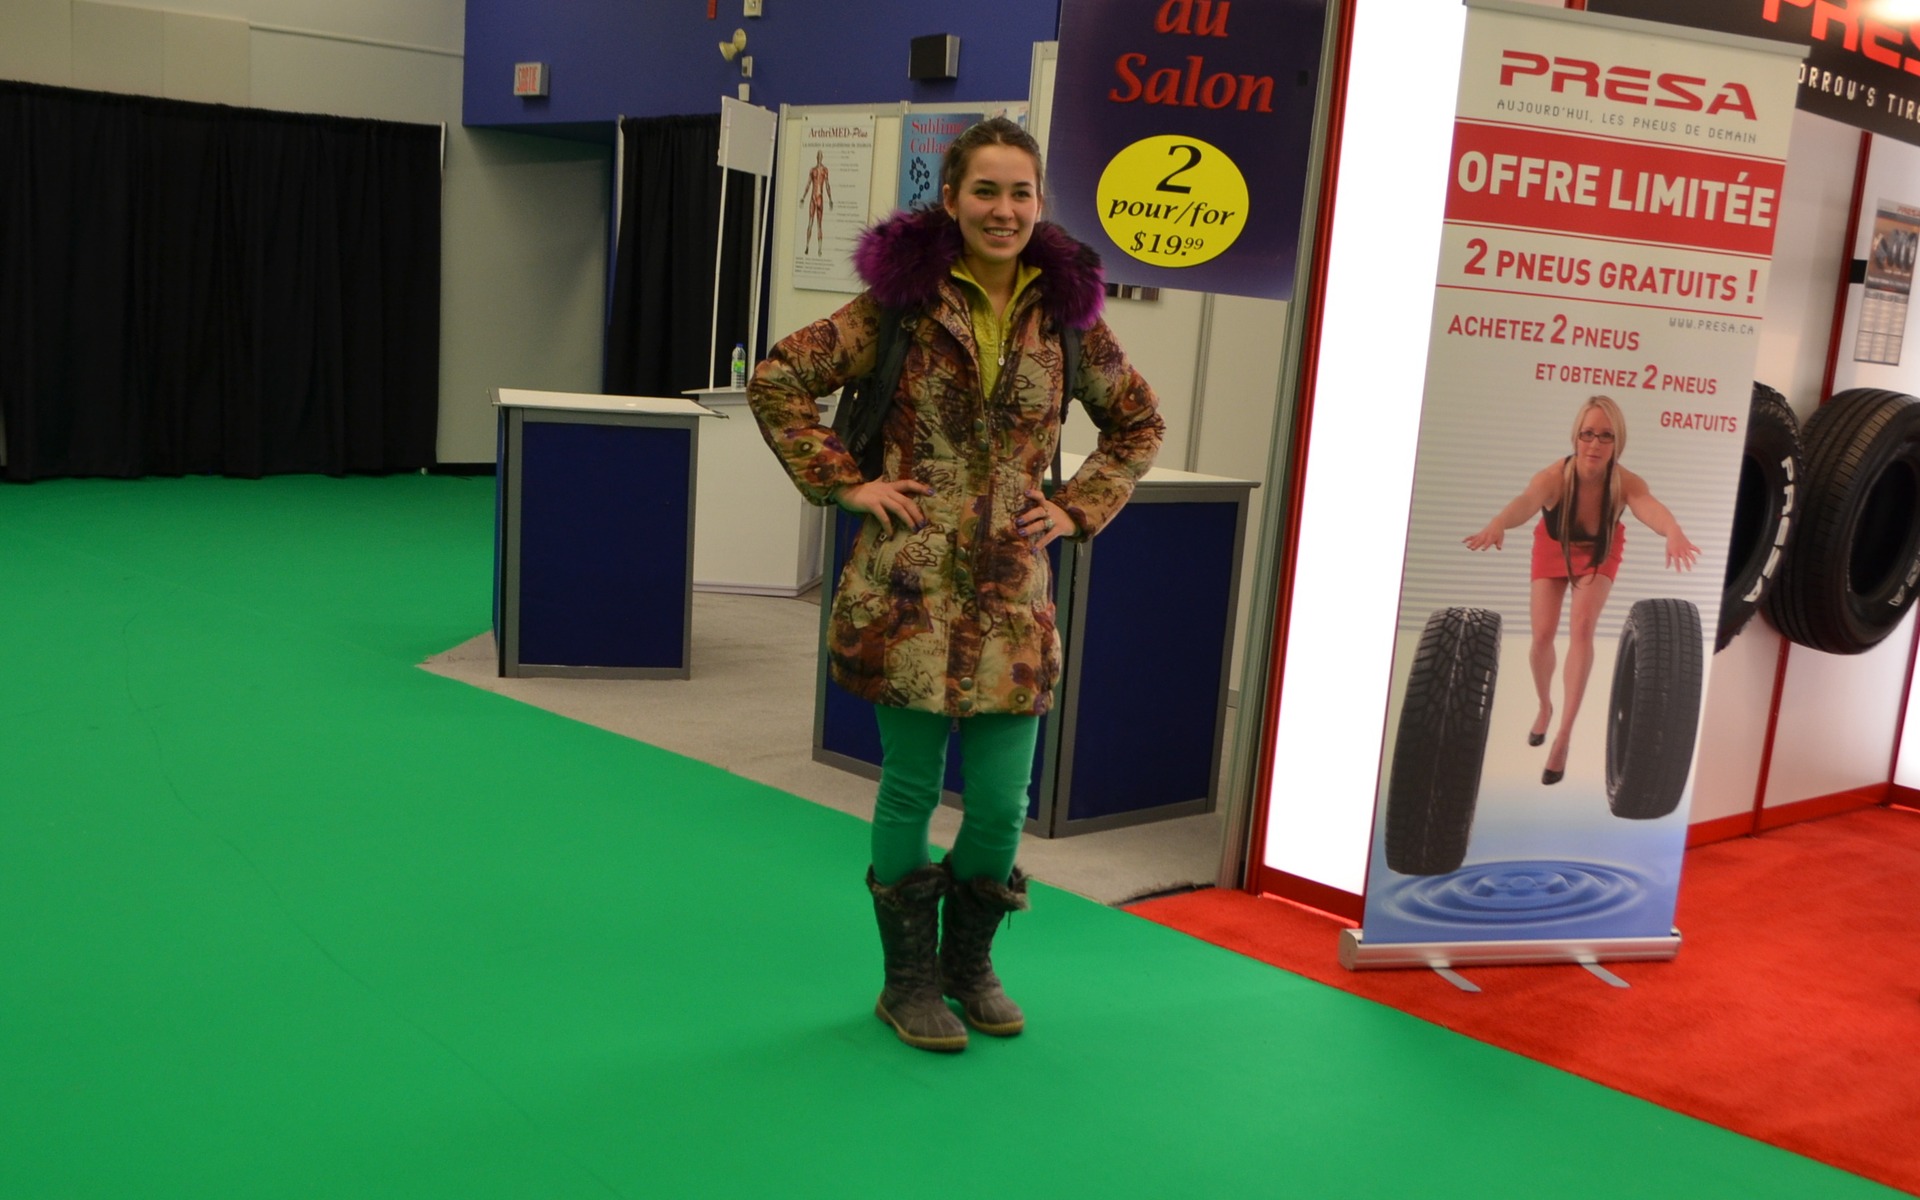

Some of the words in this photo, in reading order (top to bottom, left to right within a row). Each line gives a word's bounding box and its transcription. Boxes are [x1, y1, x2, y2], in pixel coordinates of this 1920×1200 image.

[1154, 0, 1231, 37] au
[1108, 52, 1275, 113] Salon
[1500, 50, 1757, 121] PRESA
[1497, 99, 1594, 124] AUJOURD'HUI,
[1602, 113, 1624, 127] LES
[1633, 117, 1676, 134] PNEUS
[1685, 124, 1701, 137] DE
[1708, 127, 1757, 144] DEMAIN
[1156, 144, 1202, 194] 2
[1457, 151, 1600, 206] OFFRE
[1609, 168, 1775, 228] LIMITÉE
[1108, 199, 1235, 227] pour/for
[1130, 230, 1204, 256] $19.99
[1463, 238, 1488, 276] 2
[1496, 250, 1591, 286] PNEUS
[1599, 261, 1738, 302] GRATUITS
[1447, 314, 1545, 343] ACHETEZ
[1550, 313, 1567, 345] 2
[1572, 326, 1640, 351] PNEUS
[1669, 317, 1755, 335] WWW.PRESA.CA
[1535, 363, 1556, 381] ET
[1560, 365, 1638, 388] OBTENEZ
[1642, 364, 1658, 390] 2
[1662, 374, 1717, 395] PNEUS
[1660, 411, 1738, 433] GRATUITS
